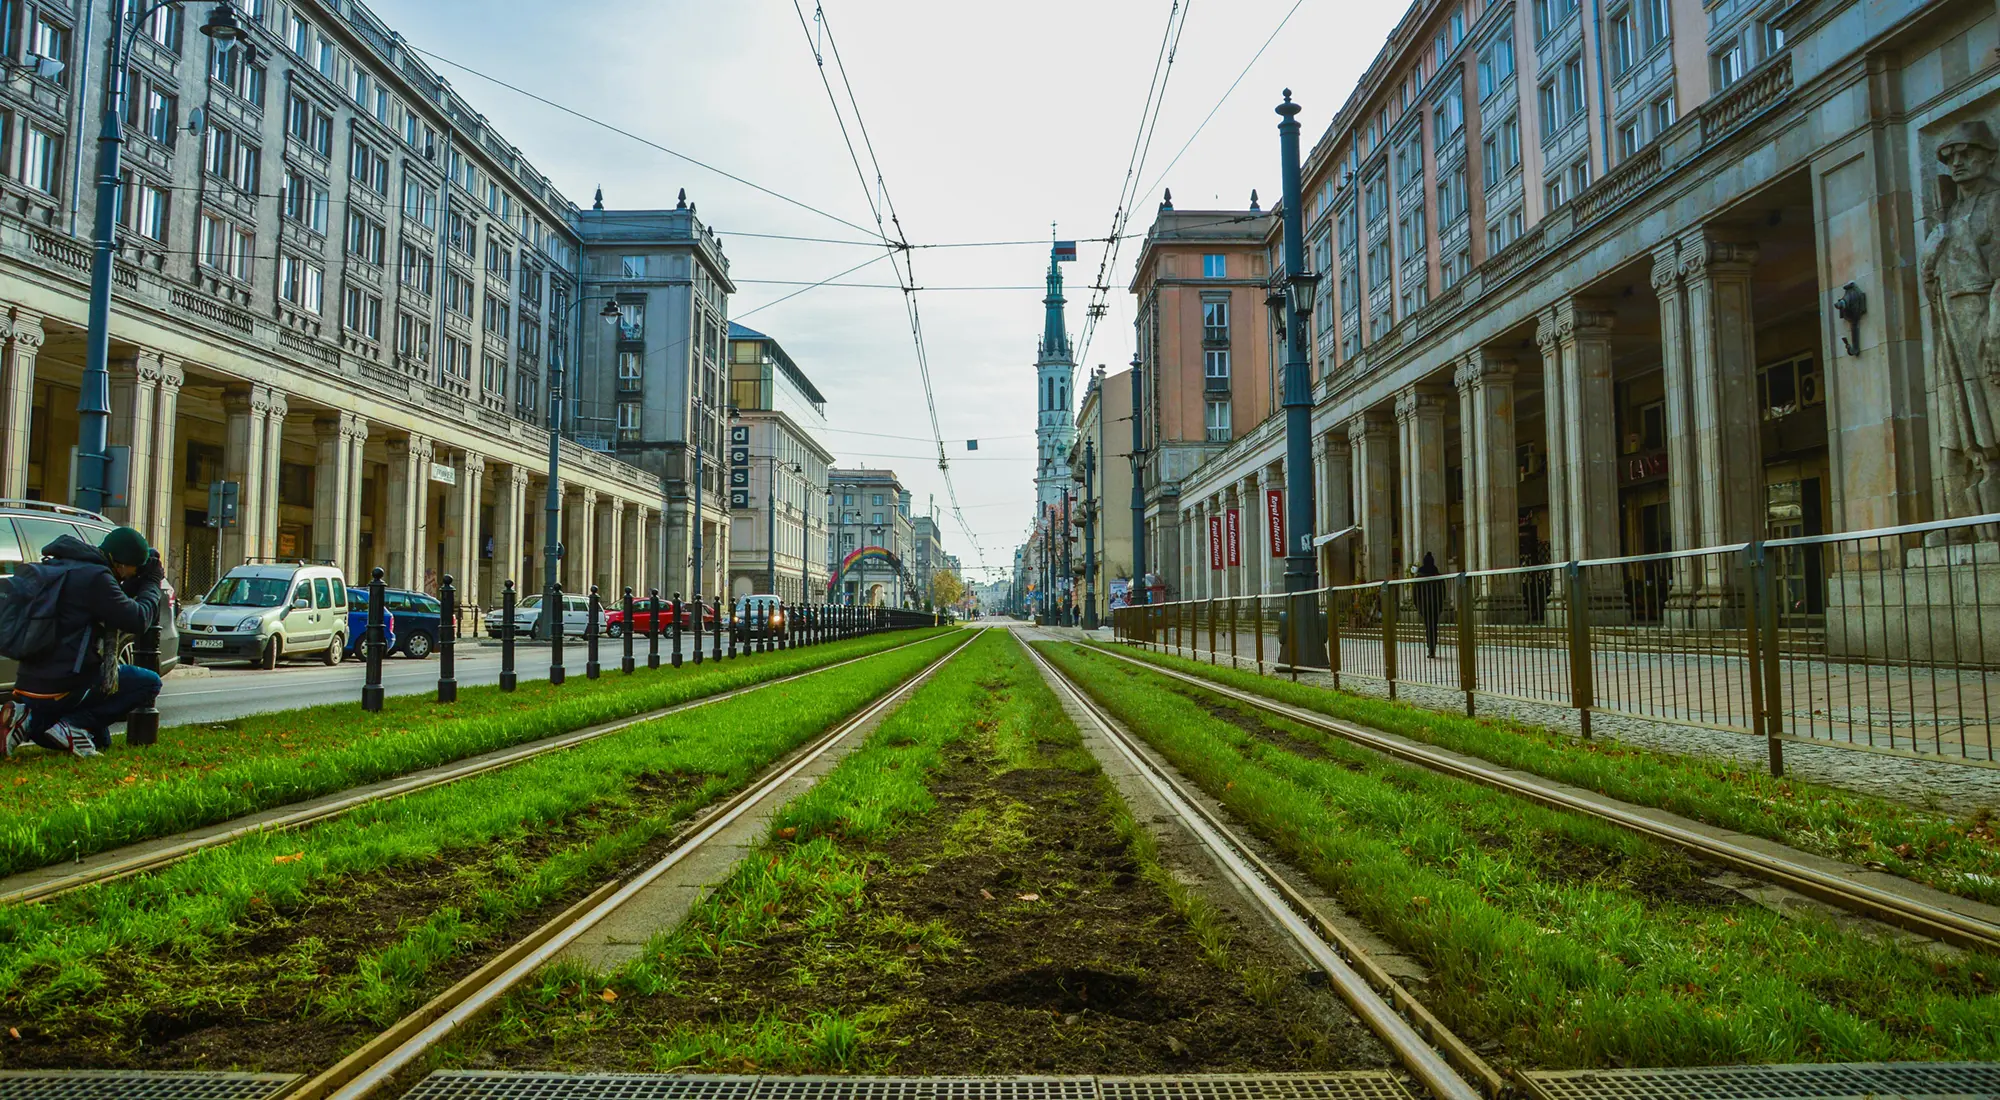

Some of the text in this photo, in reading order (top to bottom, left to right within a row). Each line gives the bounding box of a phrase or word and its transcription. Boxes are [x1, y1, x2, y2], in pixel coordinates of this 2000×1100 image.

[733, 428, 745, 504] desa
[1271, 495, 1281, 552] Royal Collection
